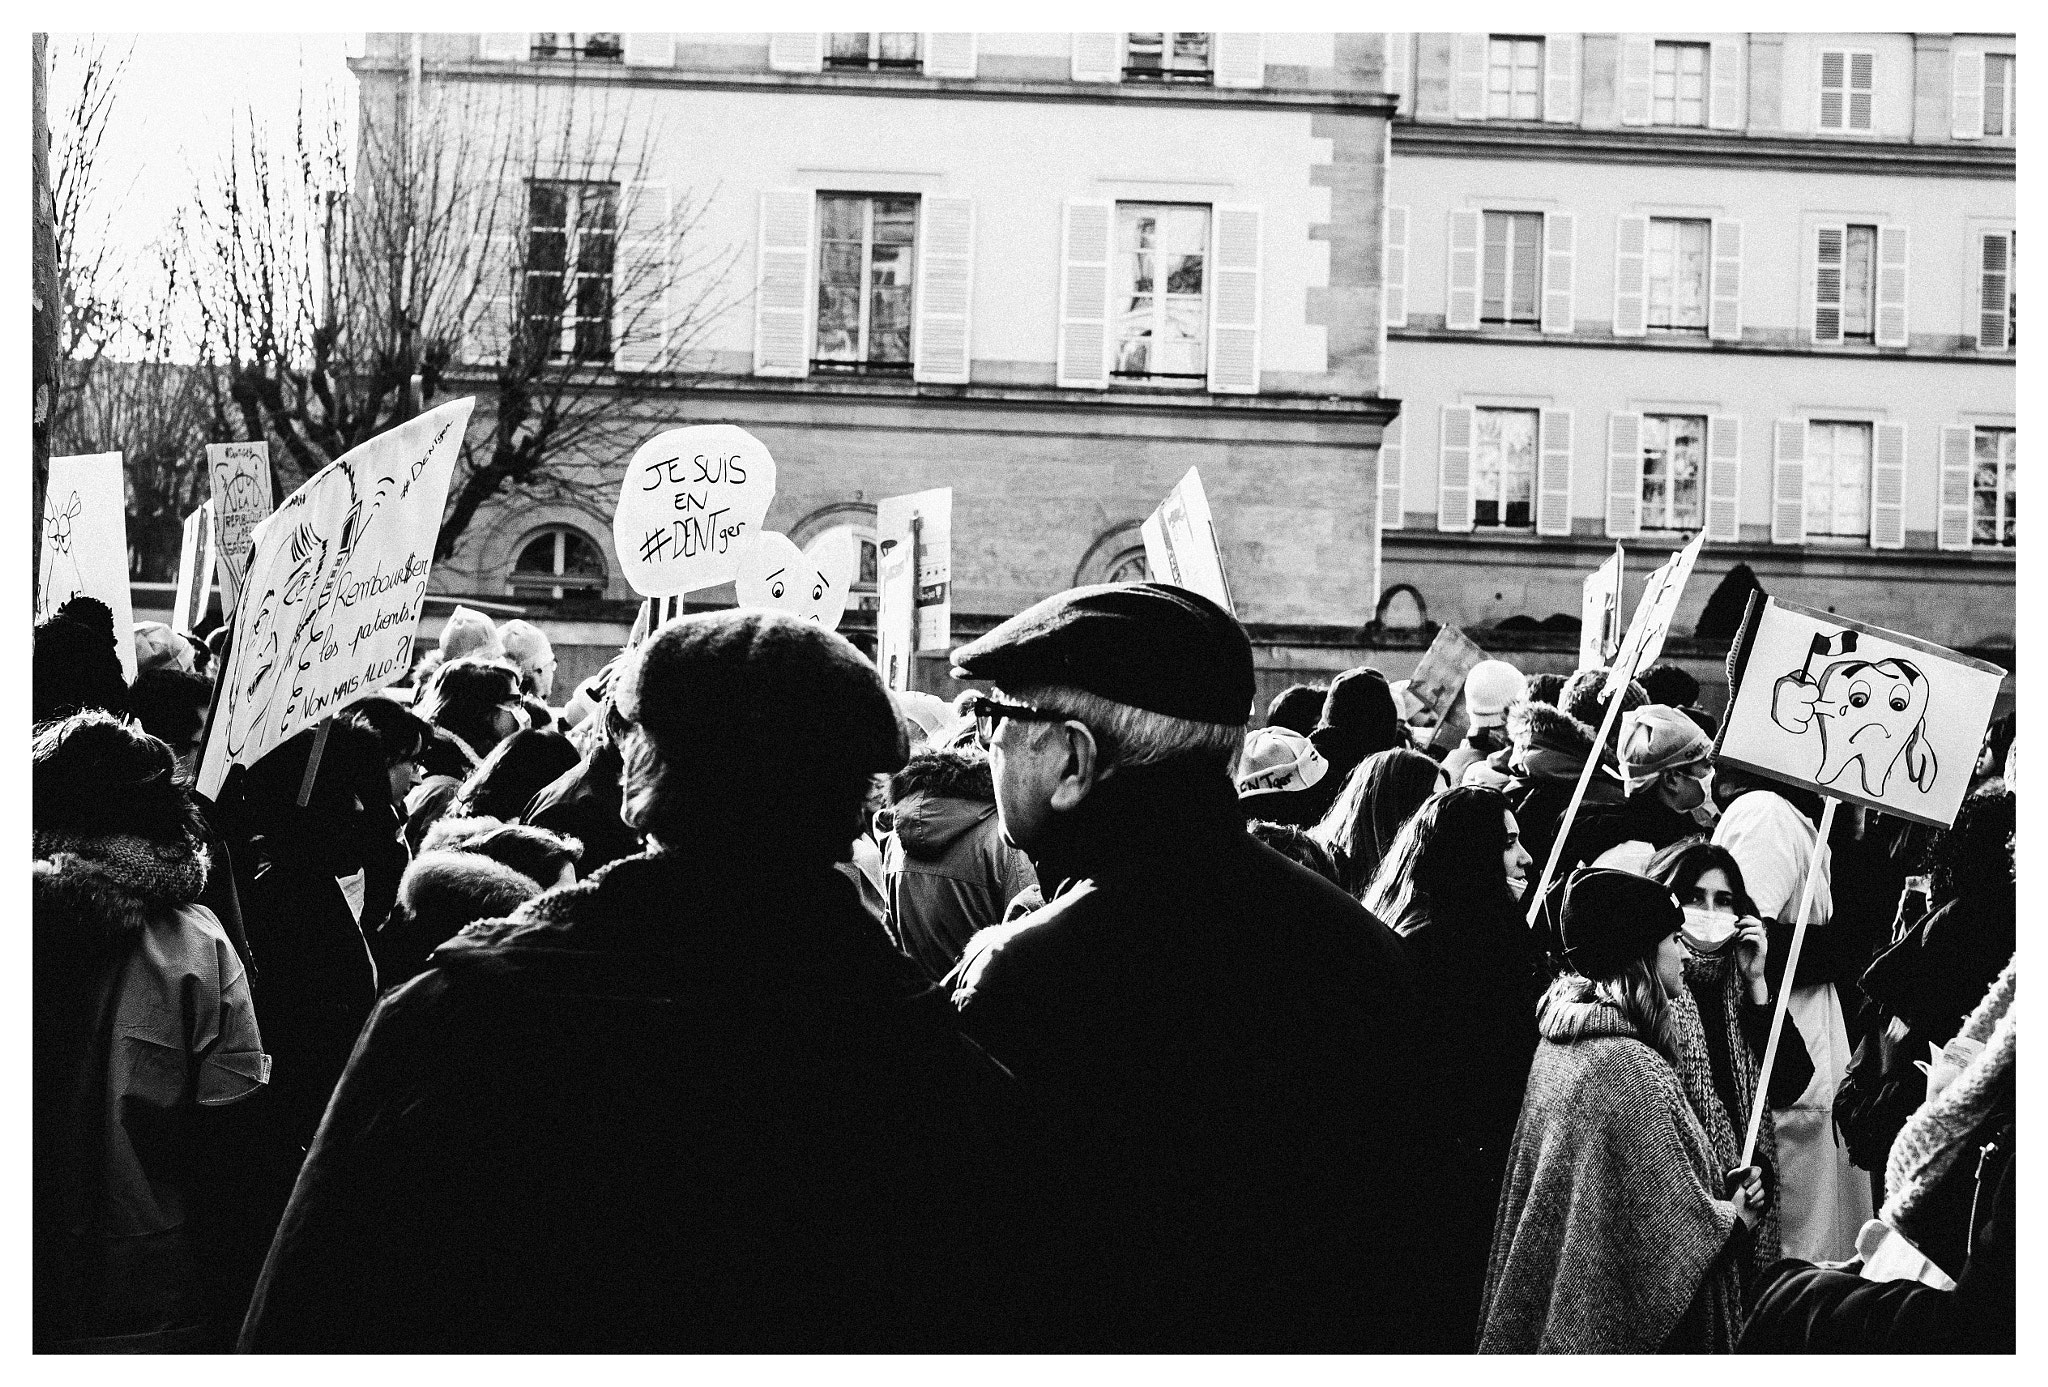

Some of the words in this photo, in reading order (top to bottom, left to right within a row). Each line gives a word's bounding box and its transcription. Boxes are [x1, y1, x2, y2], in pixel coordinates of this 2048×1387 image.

[642, 457, 686, 491] JE
[674, 491, 708, 512] EN
[639, 507, 746, 563] #DENTger
[319, 624, 339, 663] les
[331, 676, 359, 706] MAIS
